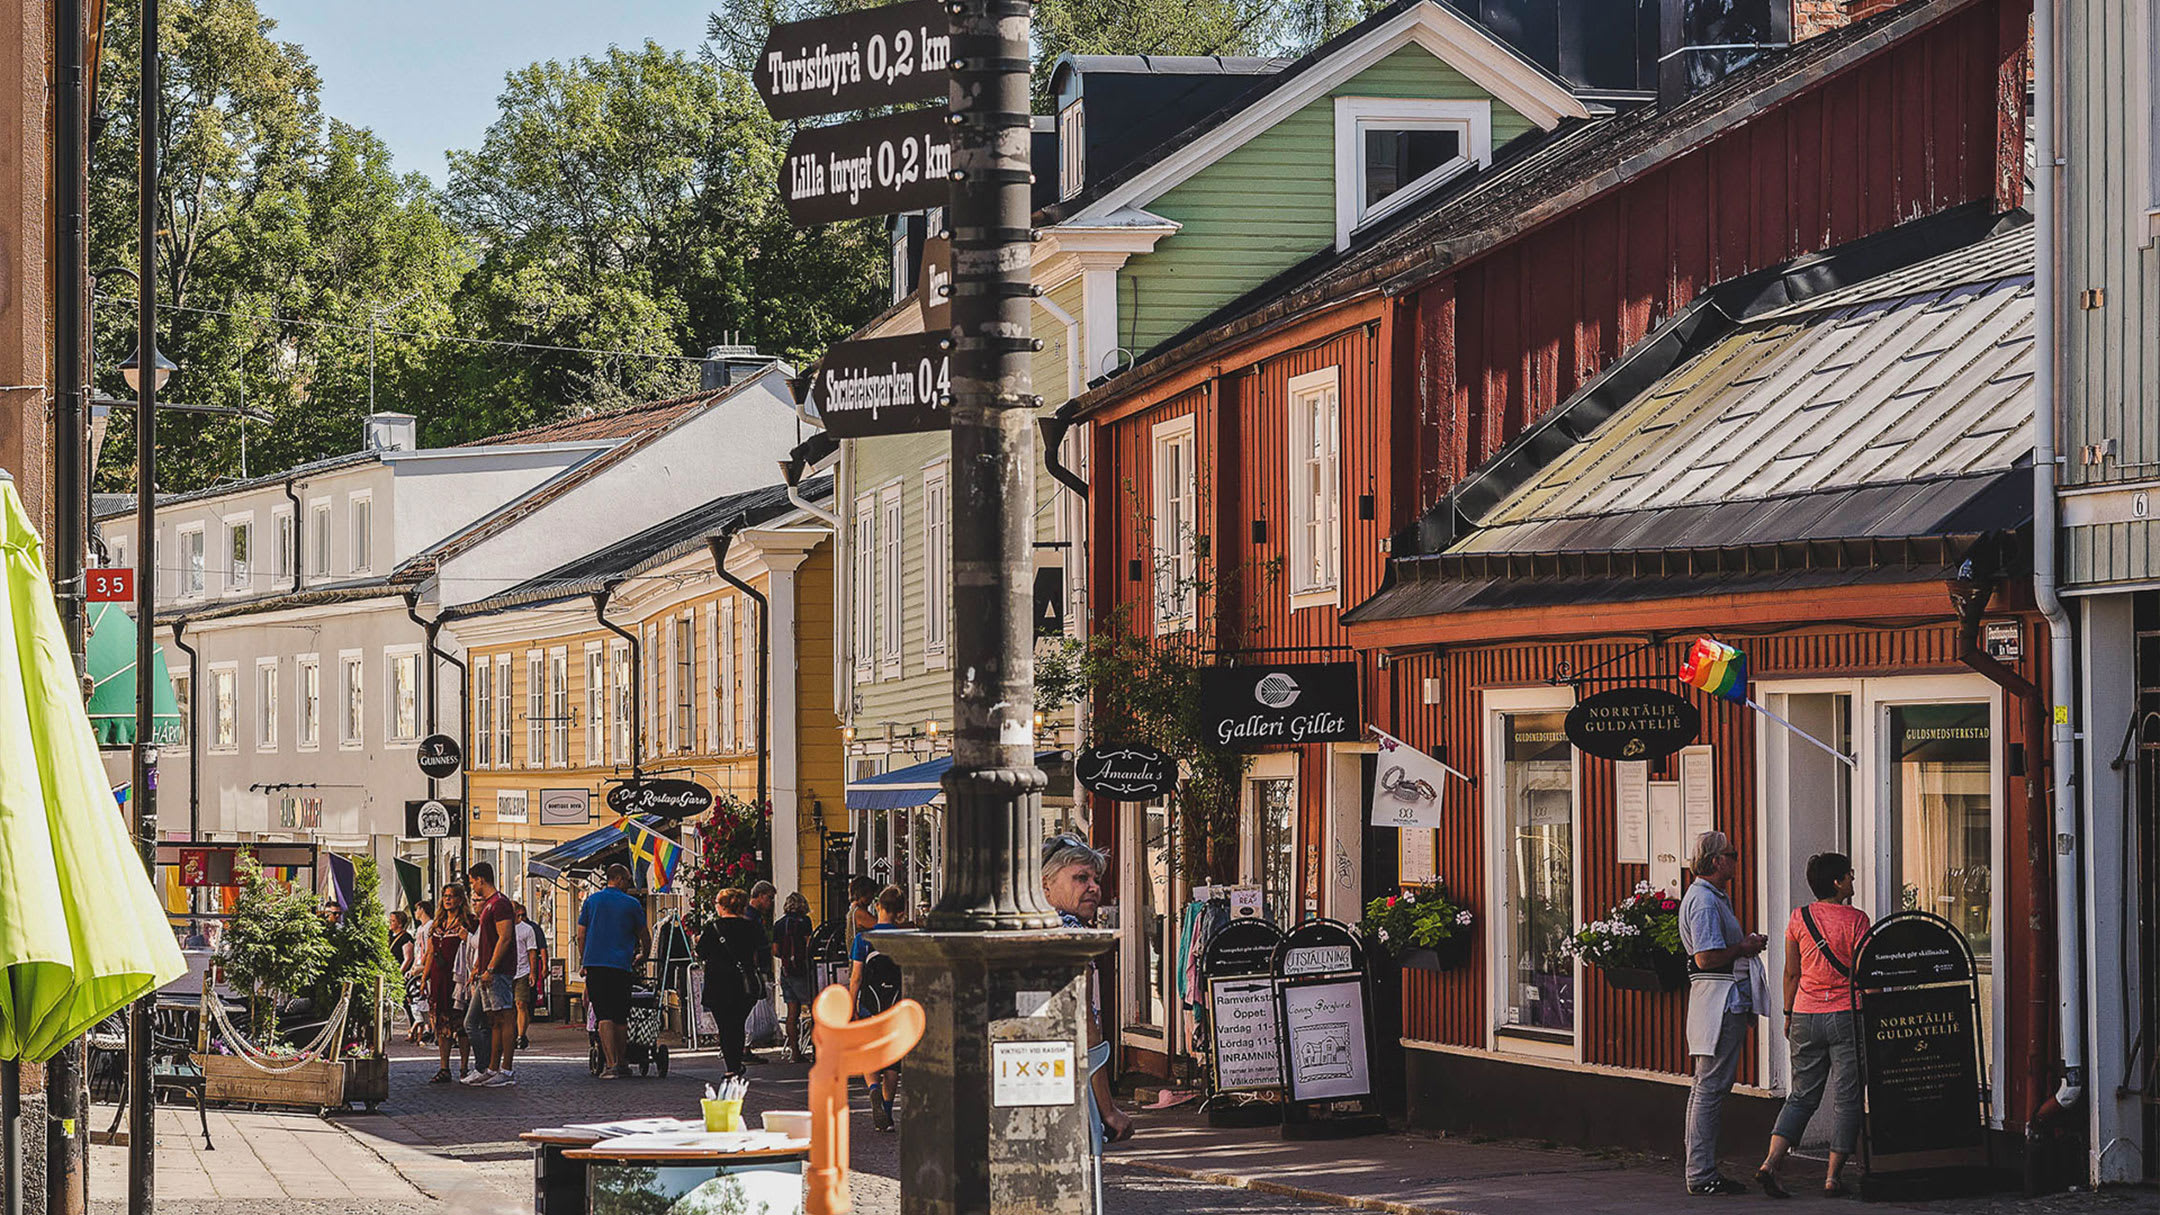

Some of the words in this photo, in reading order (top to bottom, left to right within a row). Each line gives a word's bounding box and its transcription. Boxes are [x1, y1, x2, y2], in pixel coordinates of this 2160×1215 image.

[768, 42, 861, 96] Turistbyrå
[867, 29, 913, 85] 0,2
[921, 26, 950, 72] km
[791, 153, 825, 200] Lilla
[830, 146, 872, 205] torget
[877, 136, 918, 192] 0,2
[925, 134, 951, 179] km
[826, 361, 915, 420] Societetsparken
[918, 356, 951, 409] 0,4
[2136, 494, 2144, 515] 6
[96, 577, 124, 597] 3,5
[1590, 703, 1676, 718] NORRTÄLJE
[1218, 715, 1284, 745] Galleri
[1290, 712, 1345, 742] Gillet
[1906, 728, 1990, 740] GULDSMEDSVERKSTAD
[420, 755, 458, 766] GUINNESS
[1233, 1007, 1267, 1019] Öppet:
[1880, 1012, 1955, 1028] NORRTÄLJE
[1217, 1024, 1252, 1034] Vardag
[1220, 1038, 1254, 1049] Lördag
[1230, 1076, 1281, 1085] Välkommen
